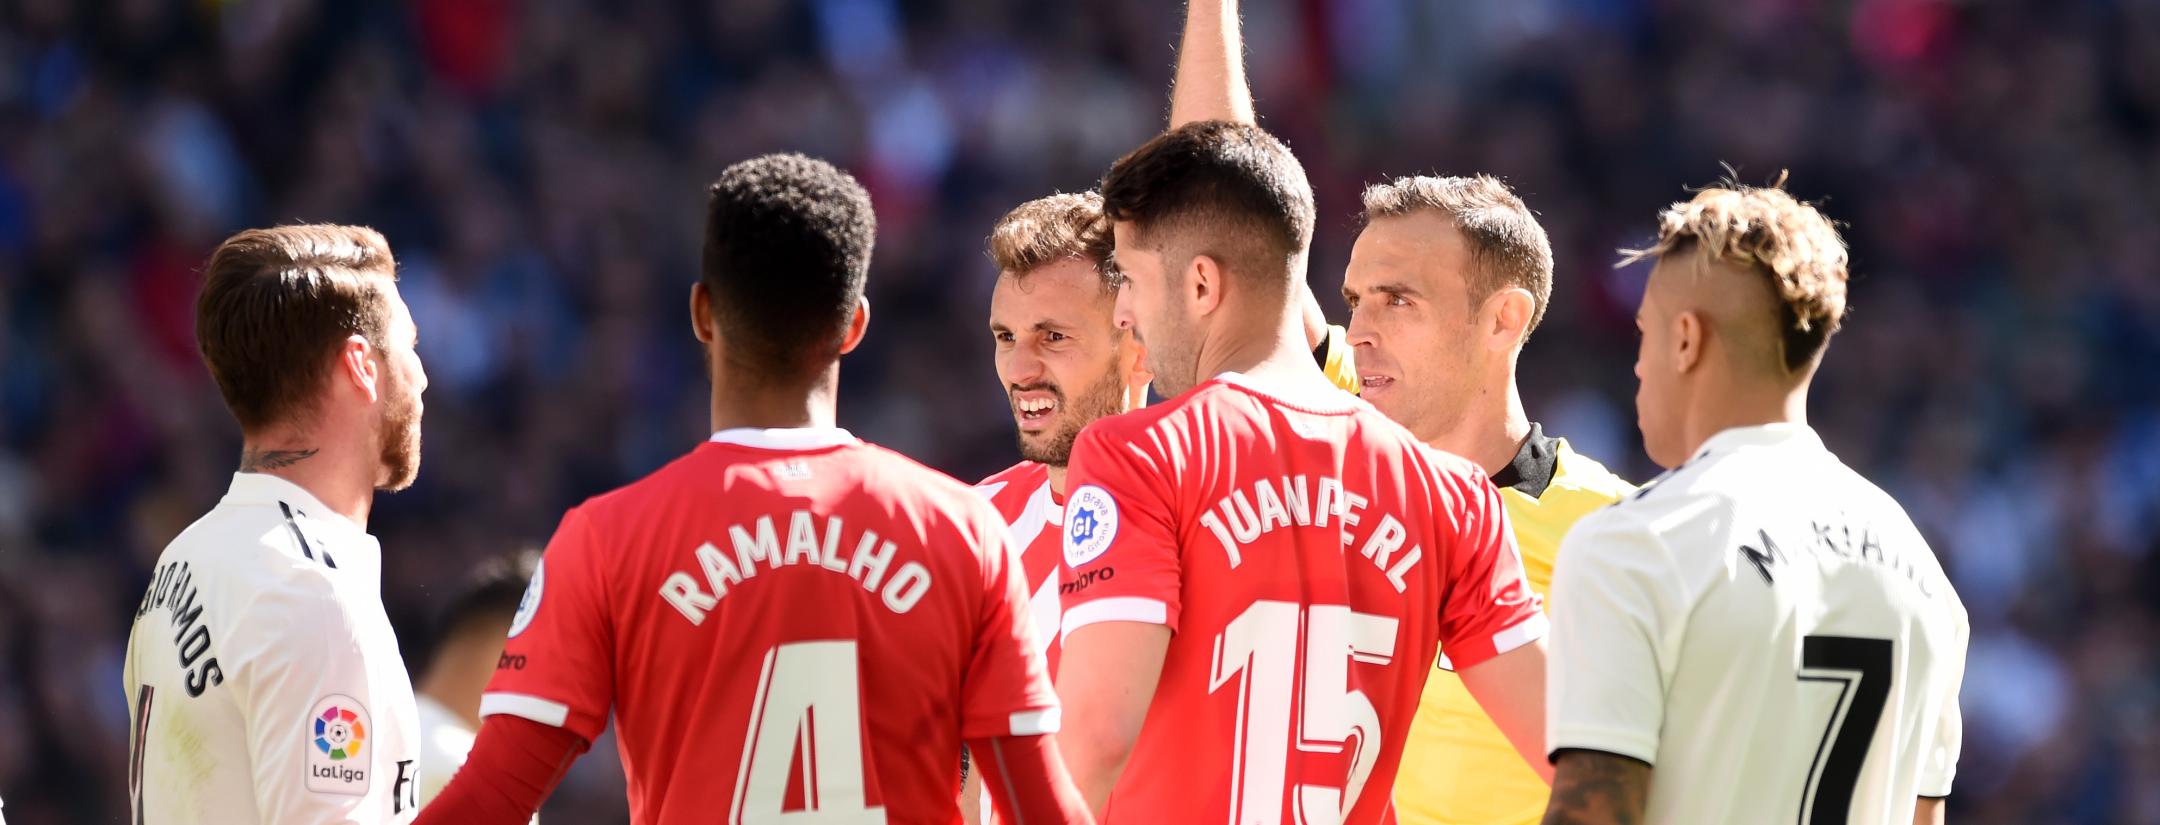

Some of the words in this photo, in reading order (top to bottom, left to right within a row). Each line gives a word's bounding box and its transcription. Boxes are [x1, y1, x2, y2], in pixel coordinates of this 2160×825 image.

[1083, 492, 1109, 517] Brava
[1200, 474, 1369, 570] JUANPE
[658, 509, 932, 626] RAMALHO
[1059, 567, 1115, 595] mbro
[497, 650, 527, 671] bro
[728, 639, 889, 825] 4
[1208, 600, 1399, 825] 15
[1797, 636, 1893, 825] 7
[312, 764, 364, 783] LaLiga
